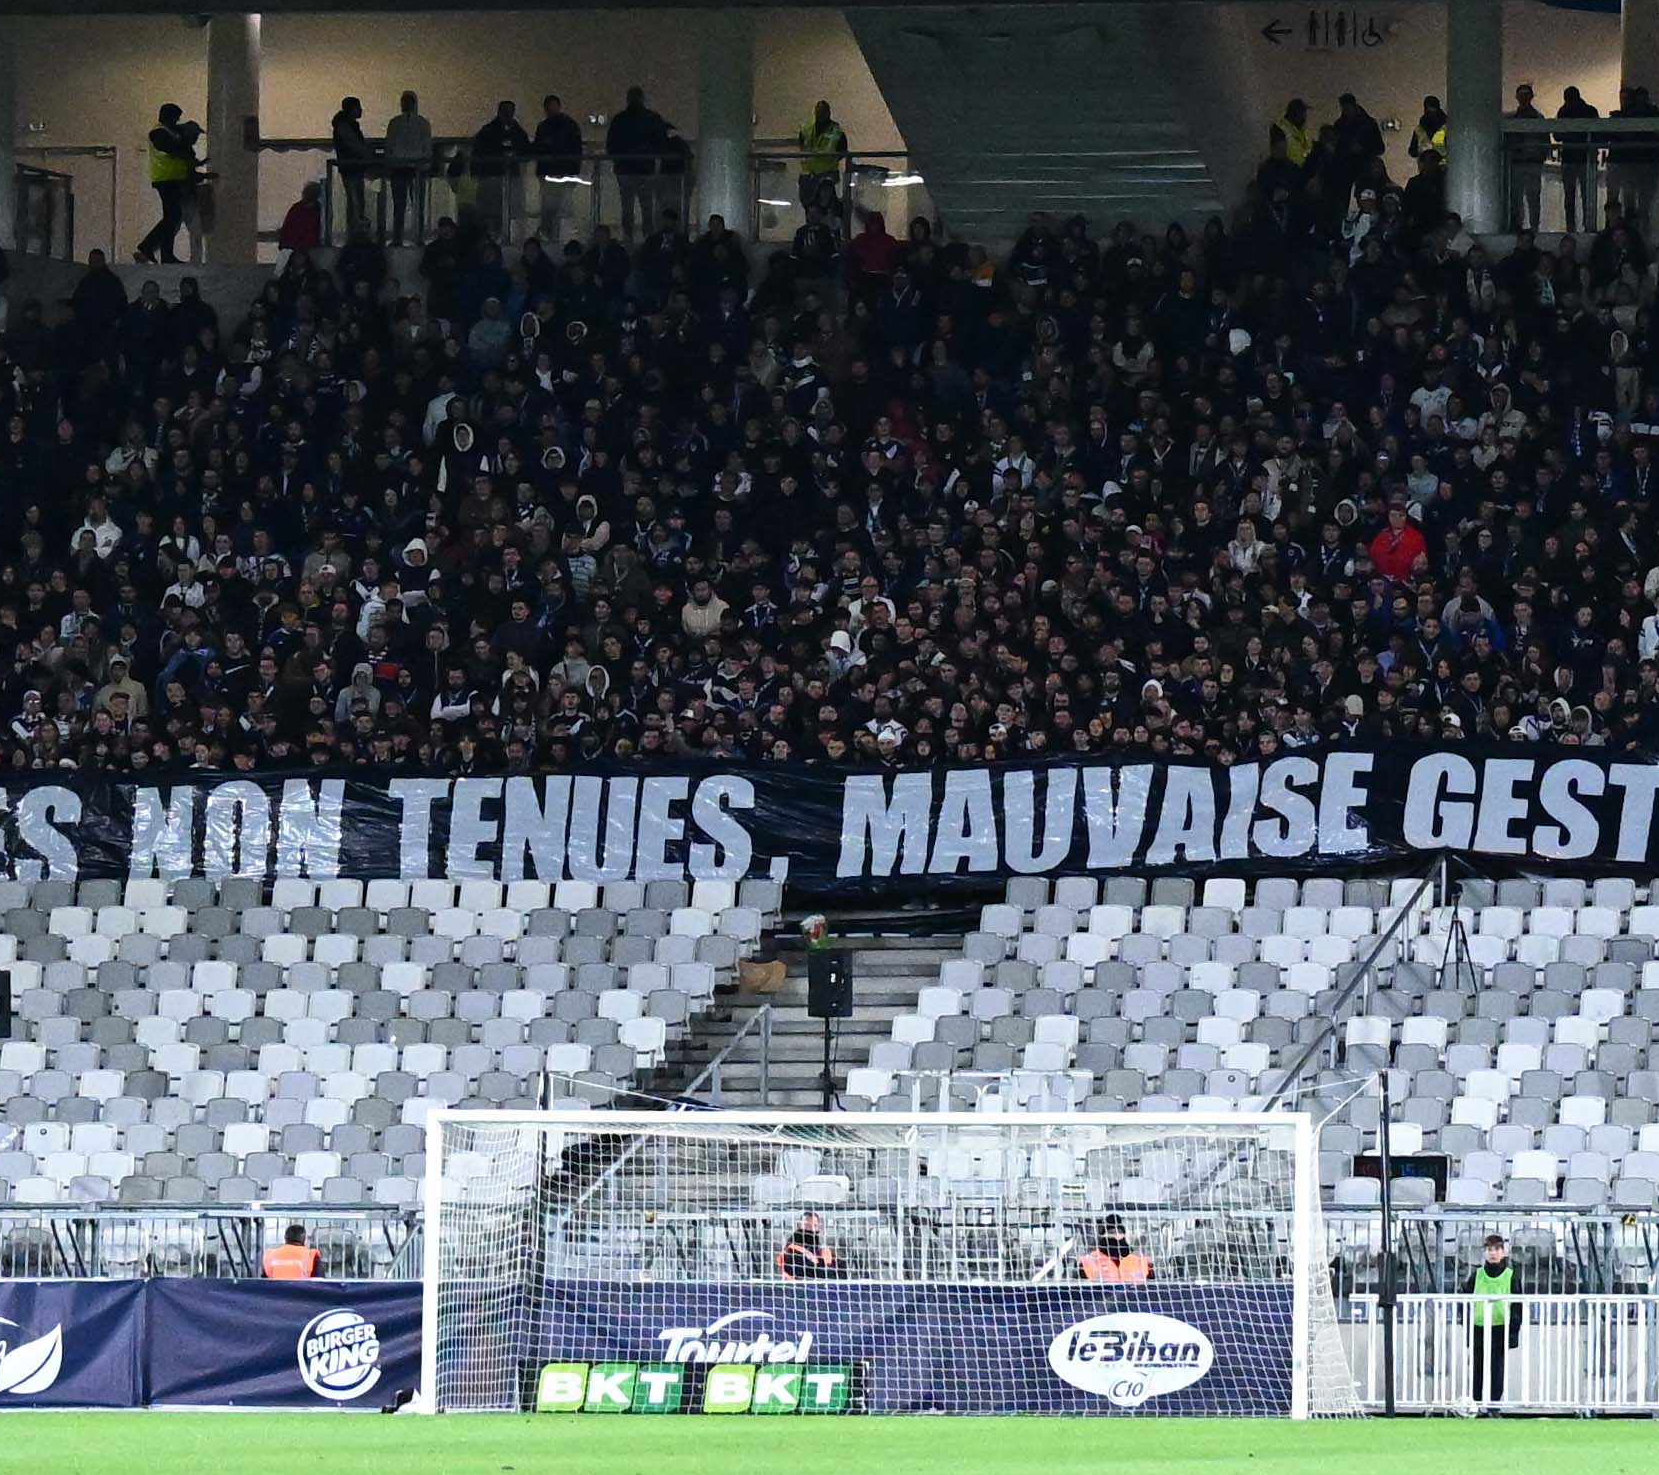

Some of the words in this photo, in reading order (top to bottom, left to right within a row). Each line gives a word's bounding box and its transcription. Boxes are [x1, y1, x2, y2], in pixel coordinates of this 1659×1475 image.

[129, 777, 345, 880] NON
[836, 751, 1375, 878] MAUVAISE
[306, 1324, 377, 1358] BURGER
[308, 1339, 380, 1382] KING
[542, 1372, 679, 1404] BKT
[708, 1372, 846, 1404] BKT
[1112, 1380, 1144, 1398] C10
